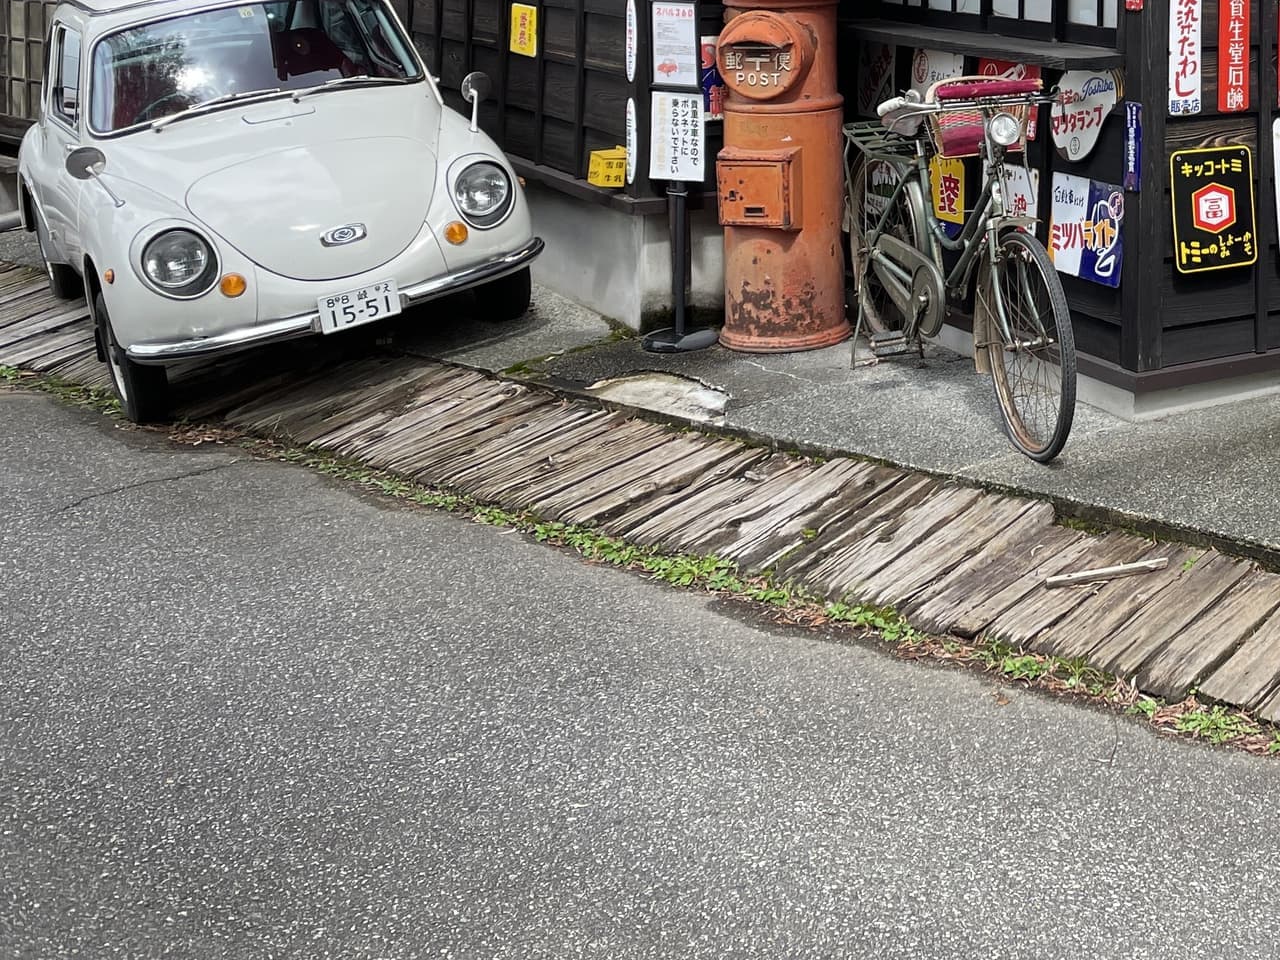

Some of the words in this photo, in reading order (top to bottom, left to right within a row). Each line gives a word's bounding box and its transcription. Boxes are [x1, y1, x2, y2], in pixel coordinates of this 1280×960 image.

[735, 72, 782, 86] POST
[1181, 158, 1242, 178] キッコートミ
[331, 295, 391, 328] 15-51
